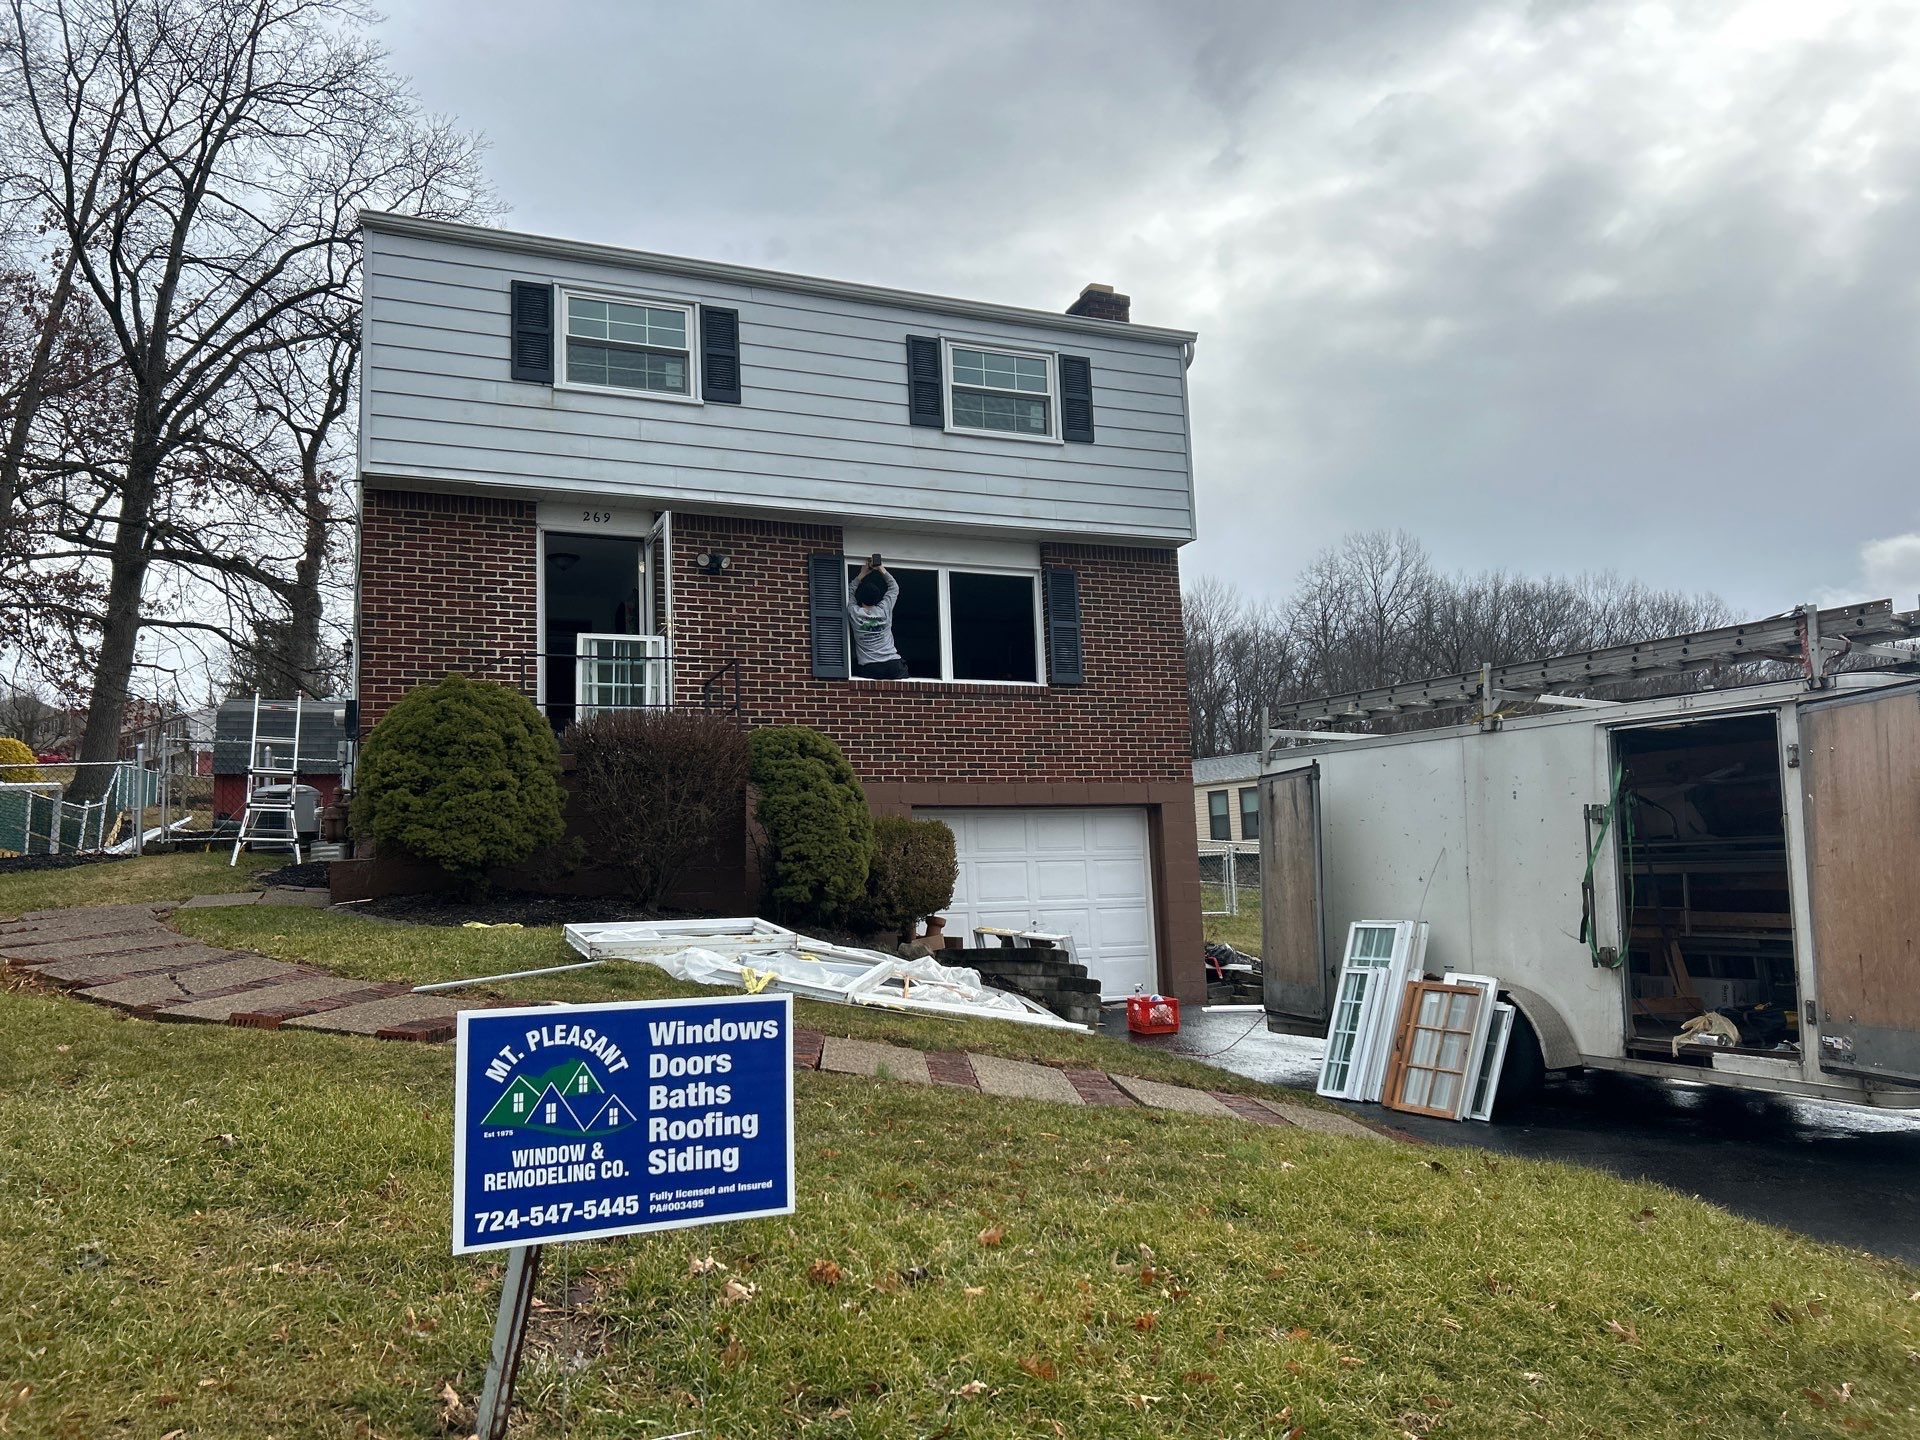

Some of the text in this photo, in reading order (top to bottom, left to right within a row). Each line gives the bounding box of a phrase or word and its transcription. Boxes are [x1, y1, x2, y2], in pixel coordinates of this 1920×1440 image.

[583, 511, 611, 523] 269
[649, 1018, 778, 1046] Windows
[485, 1024, 629, 1083] MT. PLEASANT
[649, 1053, 732, 1078] Doors
[649, 1081, 731, 1111] Baths
[496, 1129, 514, 1137] 1975
[649, 1112, 759, 1143] Roofing
[512, 1142, 604, 1168] WINDOW &
[648, 1145, 739, 1175] Siding
[484, 1160, 629, 1192] REMODELING CO.
[650, 1192, 673, 1202] Fully
[675, 1186, 715, 1198] licensed
[718, 1184, 735, 1194] and
[650, 1199, 704, 1214] PA#003495
[474, 1195, 639, 1234] 724-547-5445
